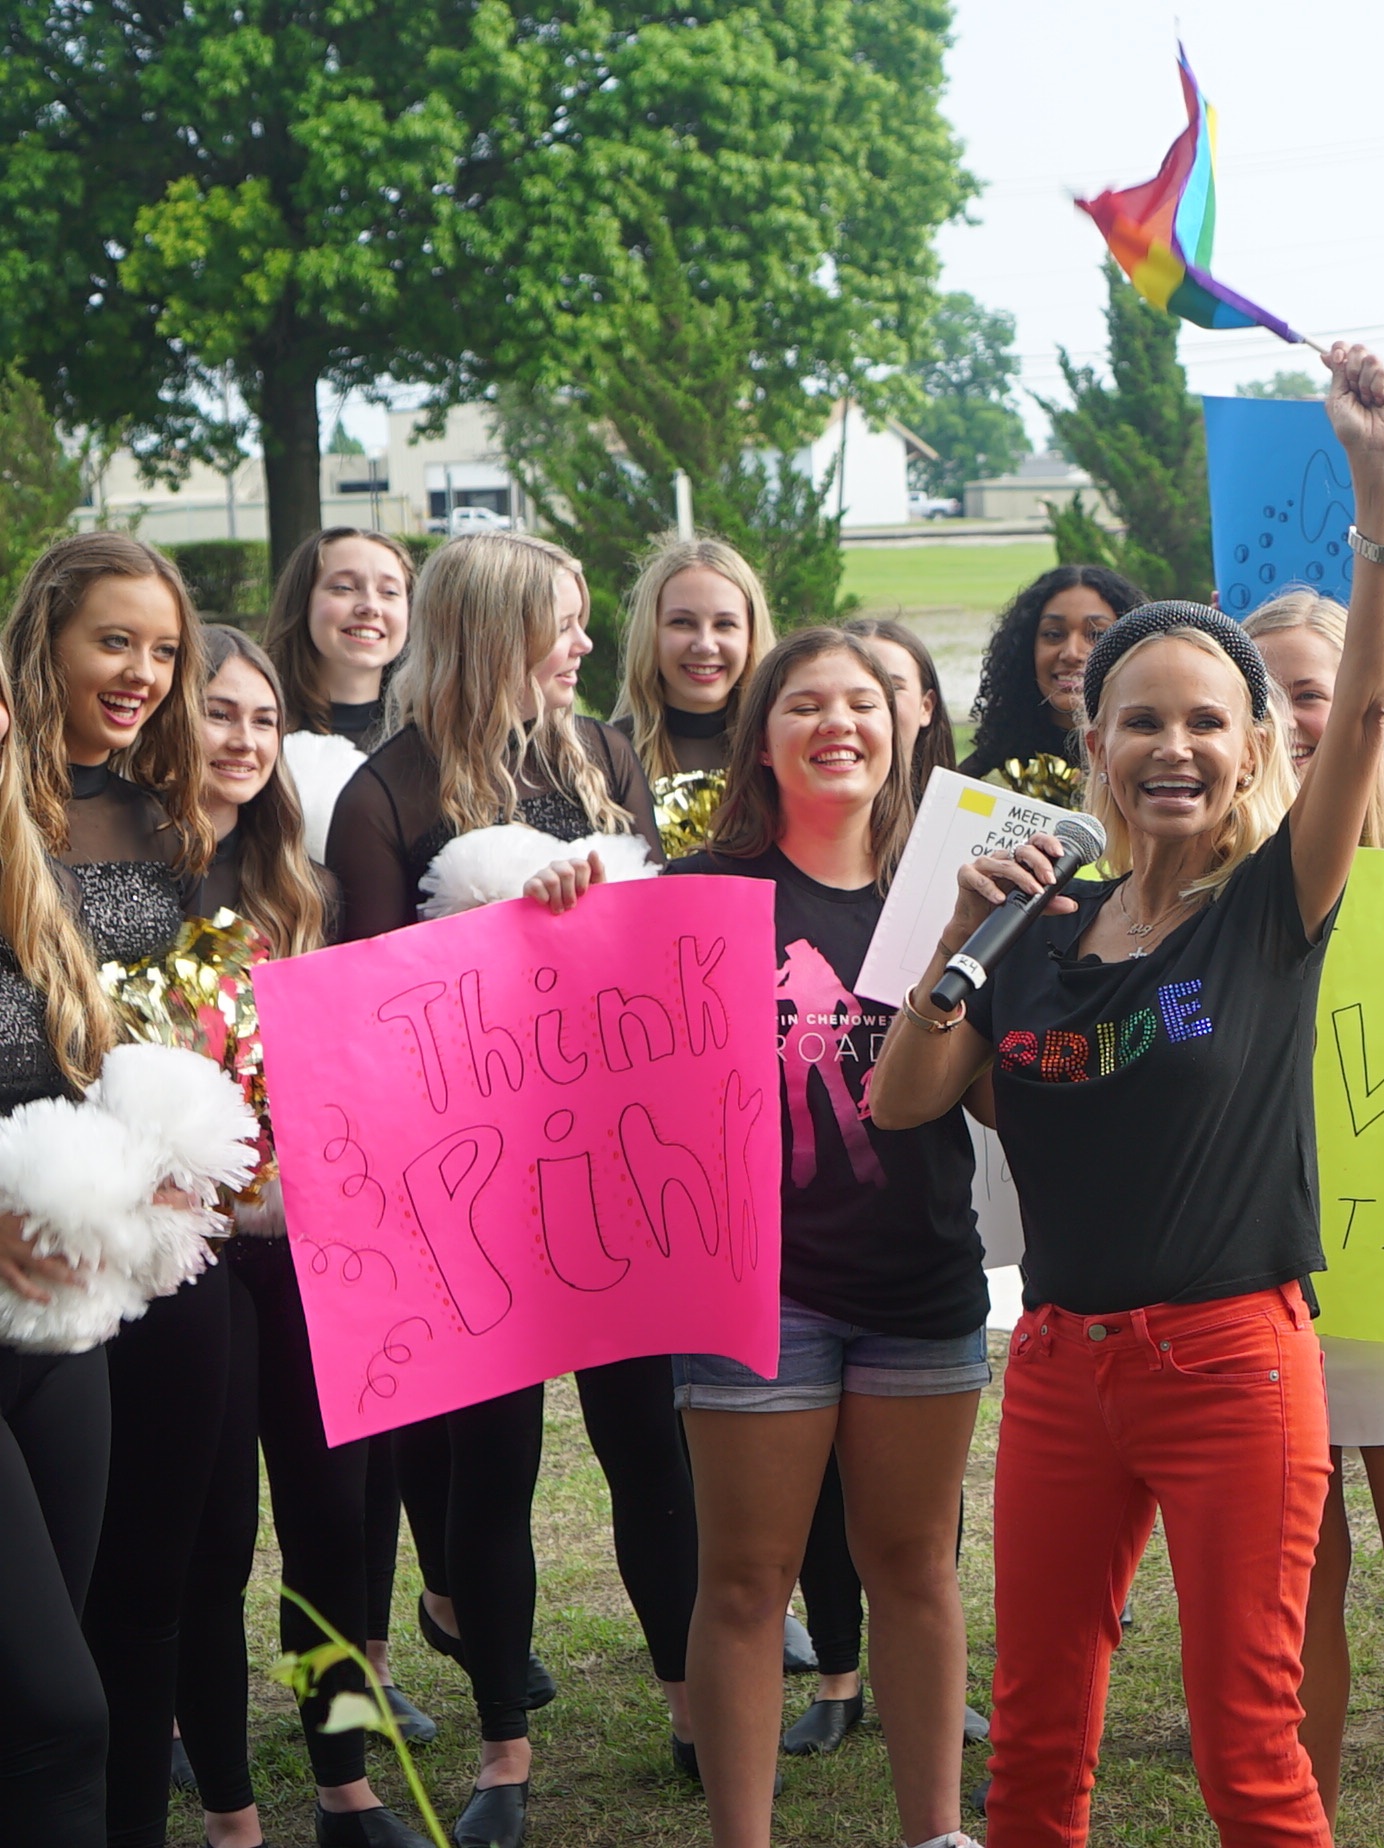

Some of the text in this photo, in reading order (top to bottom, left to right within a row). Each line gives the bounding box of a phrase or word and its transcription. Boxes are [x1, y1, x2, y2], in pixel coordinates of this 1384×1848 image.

[1008, 806, 1051, 828] MEET
[1002, 821, 1047, 839] SOM
[986, 831, 1019, 850] FAM
[971, 844, 995, 857] OK
[776, 1013, 799, 1026] IN
[999, 979, 1213, 1083] PRIDE
